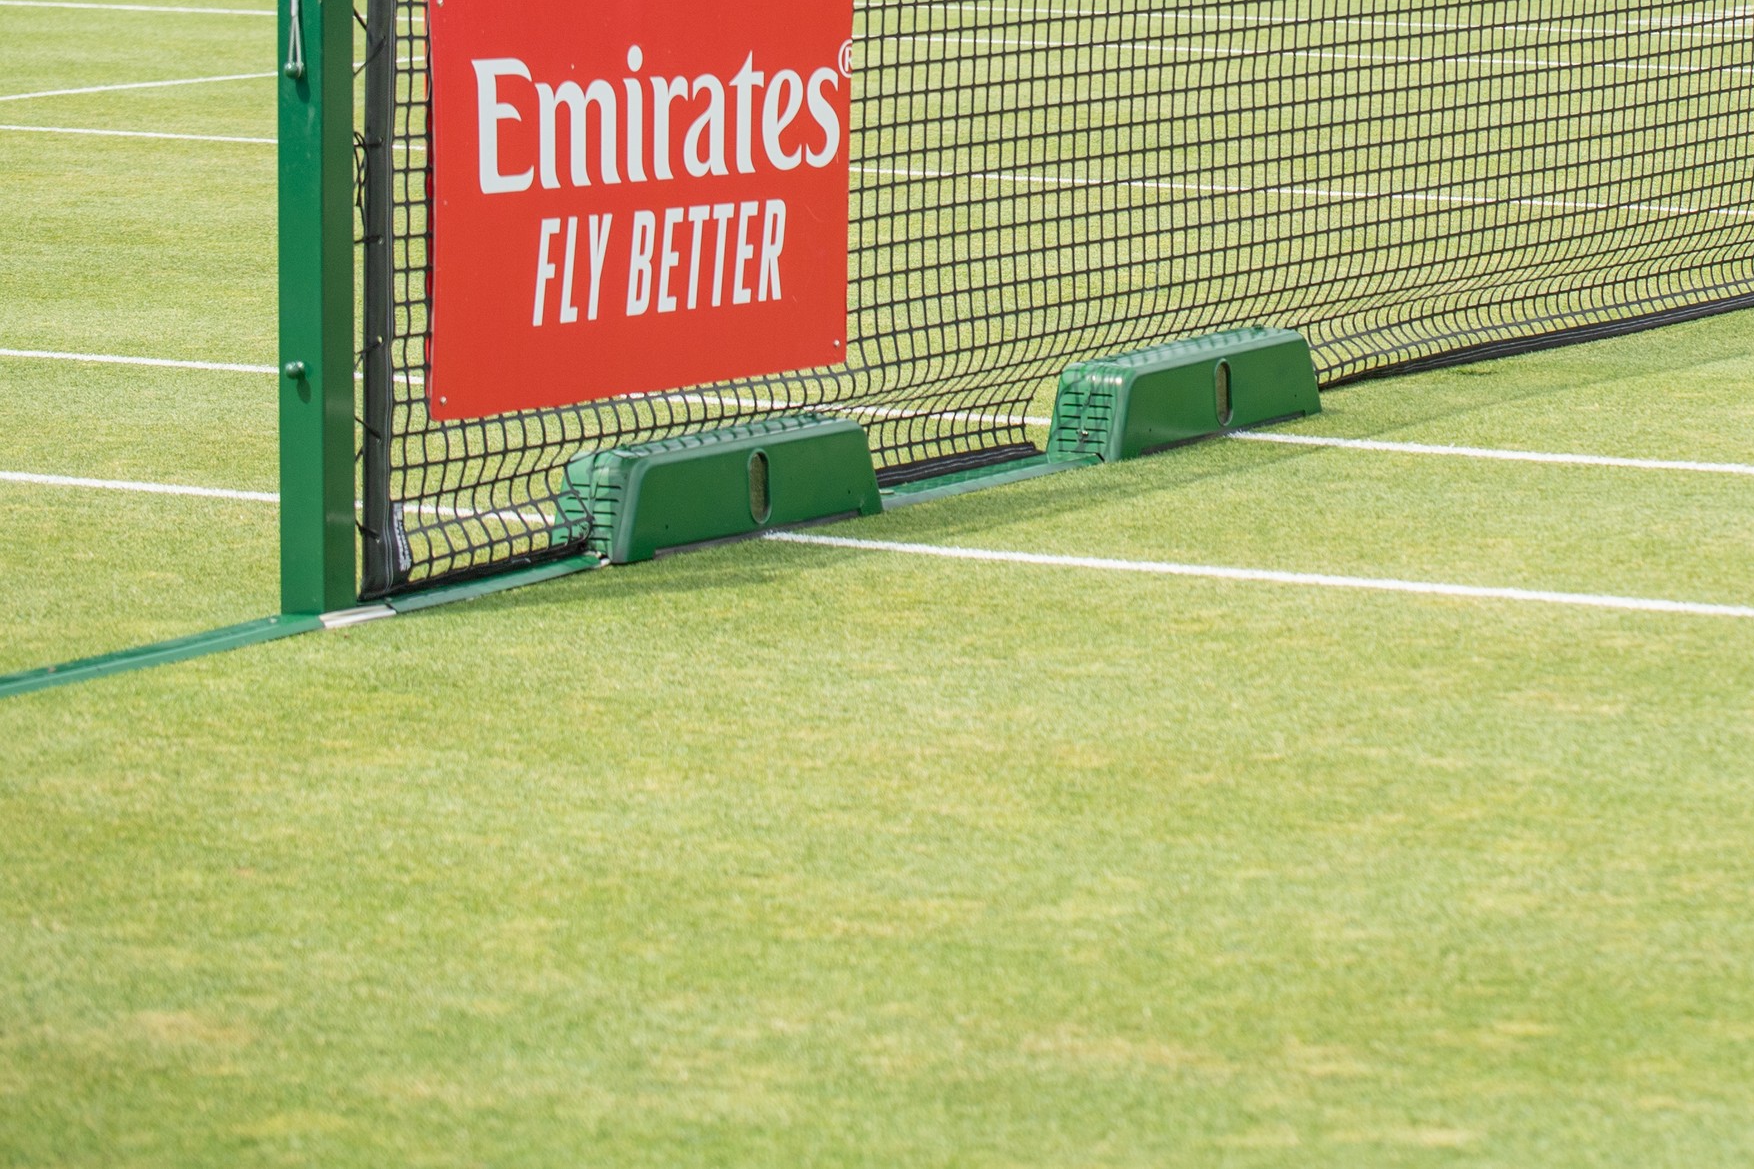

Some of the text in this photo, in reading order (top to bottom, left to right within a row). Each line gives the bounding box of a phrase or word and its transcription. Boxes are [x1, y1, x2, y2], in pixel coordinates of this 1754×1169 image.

[471, 44, 841, 195] Emirates
[532, 198, 787, 327] FLY BETTER
